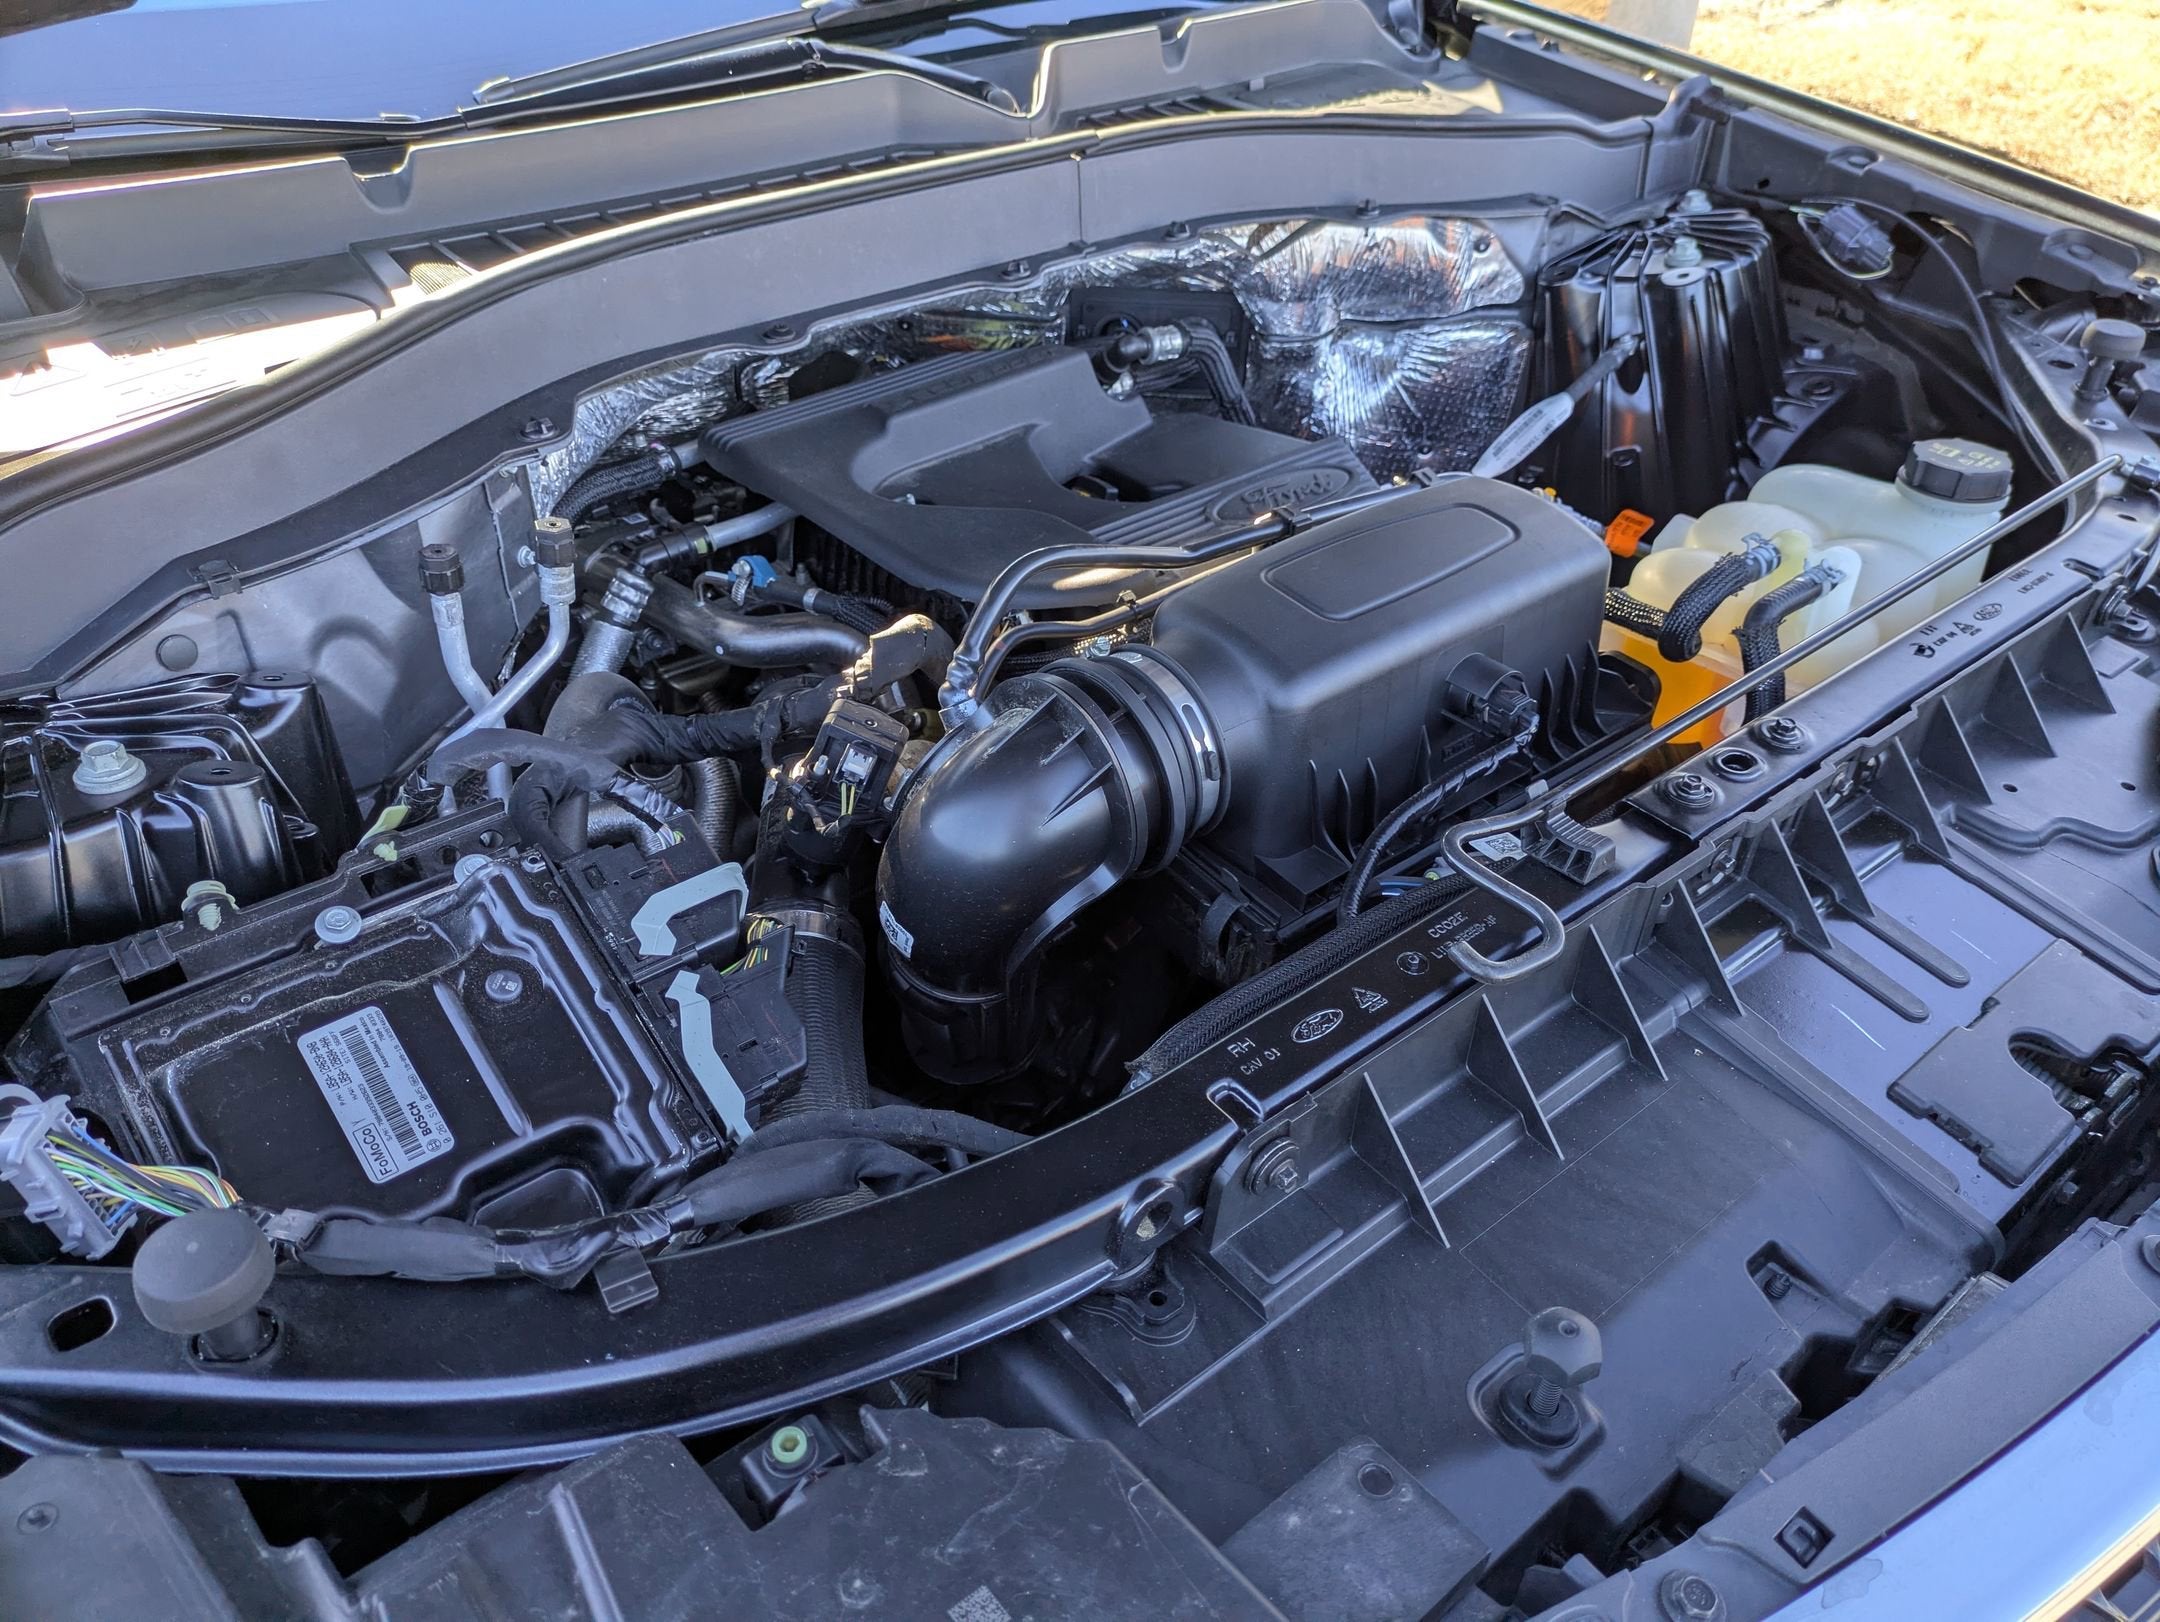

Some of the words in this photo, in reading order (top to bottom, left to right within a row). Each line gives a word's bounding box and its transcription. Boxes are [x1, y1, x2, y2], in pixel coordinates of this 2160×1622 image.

[1240, 473, 1332, 516] Ford
[359, 1016, 371, 1035] Mexico
[370, 1039, 390, 1069] Assembled
[1227, 1037, 1256, 1059] RH
[1240, 1056, 1263, 1076] CAV
[407, 1101, 432, 1137] BOSCH
[433, 1120, 447, 1136] 261
[362, 1128, 392, 1176] FoMoCo
